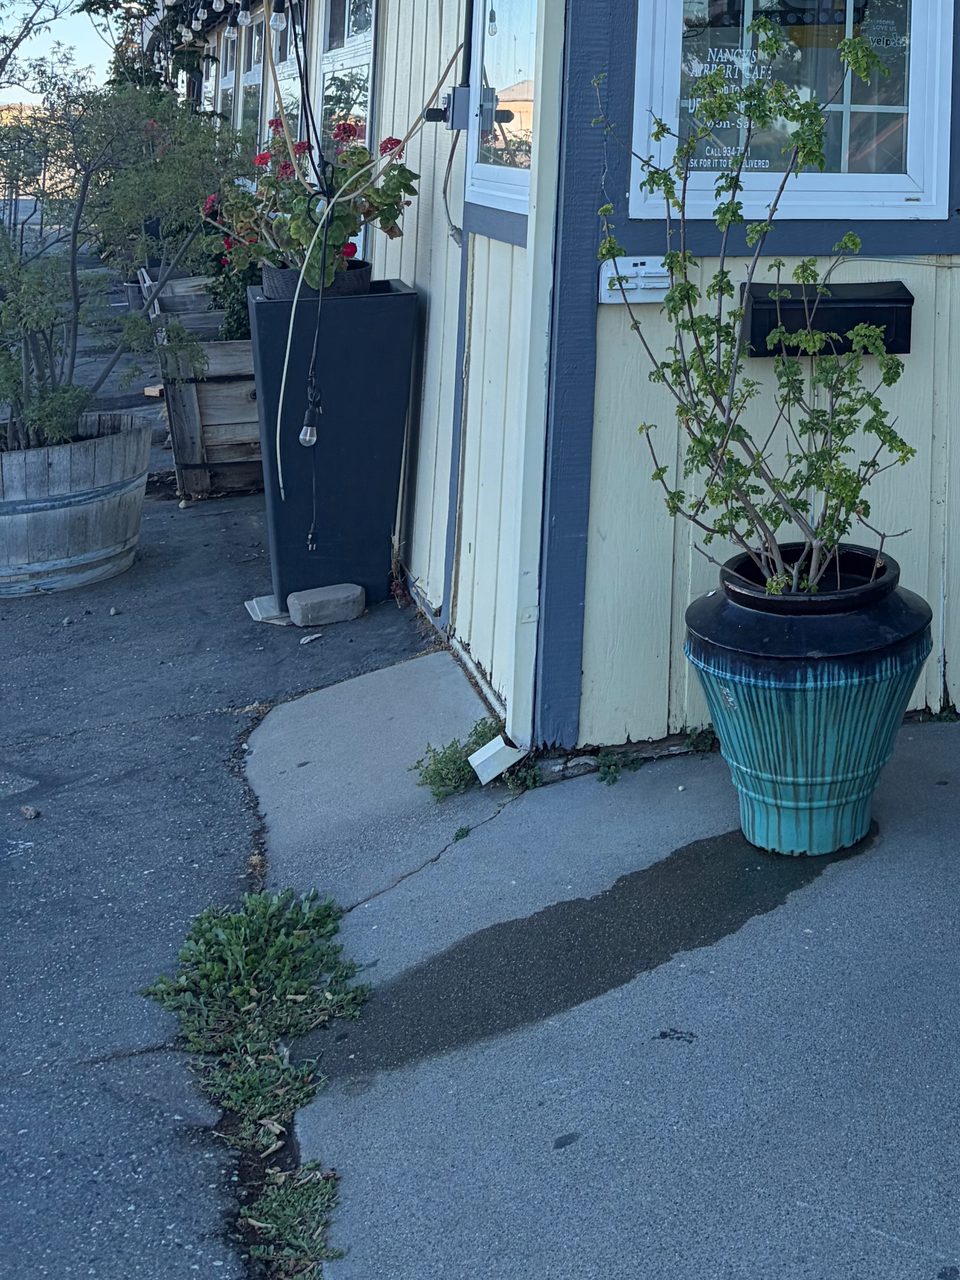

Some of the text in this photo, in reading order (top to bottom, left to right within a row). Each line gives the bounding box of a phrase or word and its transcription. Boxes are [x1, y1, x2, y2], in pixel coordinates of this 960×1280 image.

[870, 36, 891, 48] yelp
[707, 48, 757, 63] NANCY'S
[722, 146, 751, 157] 934-71
[687, 159, 698, 168] SK
[741, 159, 770, 168] ELIVERED
